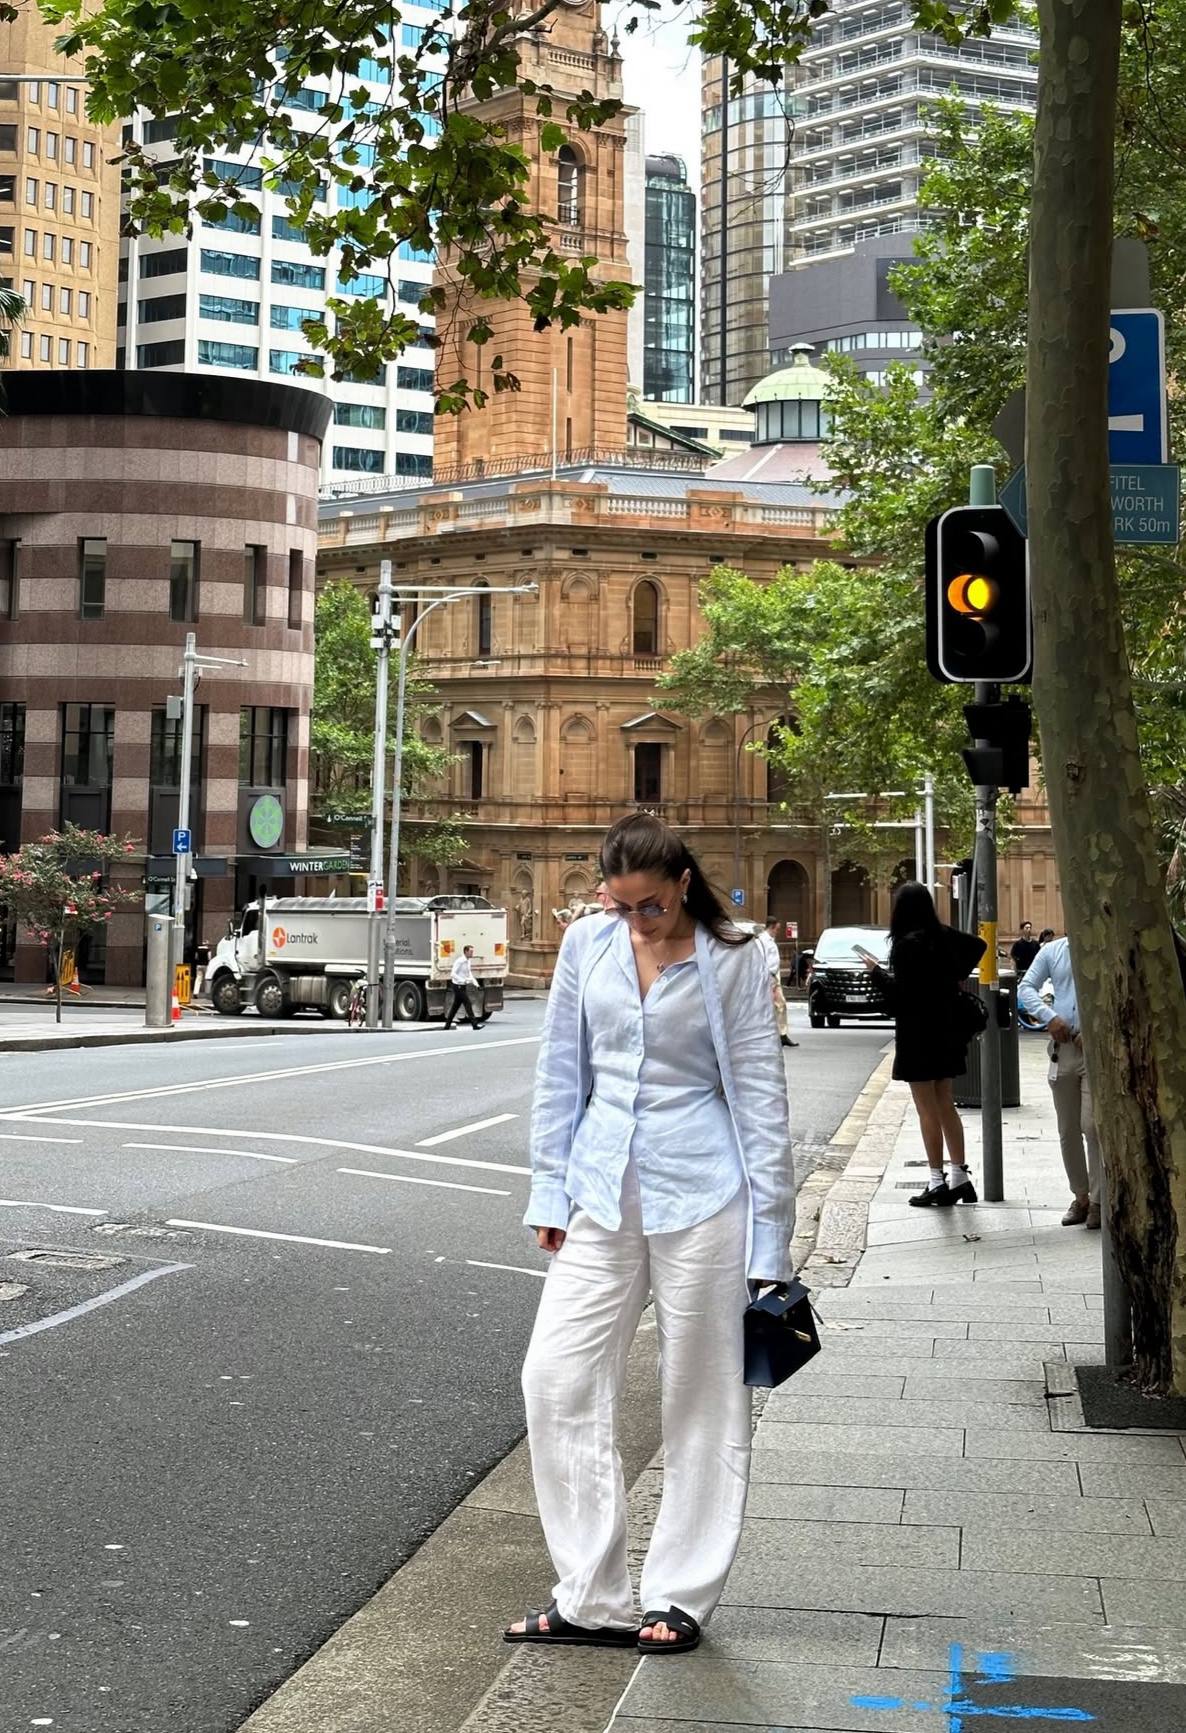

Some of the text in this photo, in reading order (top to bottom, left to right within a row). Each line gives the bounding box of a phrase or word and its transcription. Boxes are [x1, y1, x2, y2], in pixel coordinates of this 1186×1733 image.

[1110, 496, 1164, 512] WORTH
[1114, 517, 1170, 533] RK 50m
[178, 831, 186, 841] P
[286, 933, 318, 944] Lantrak
